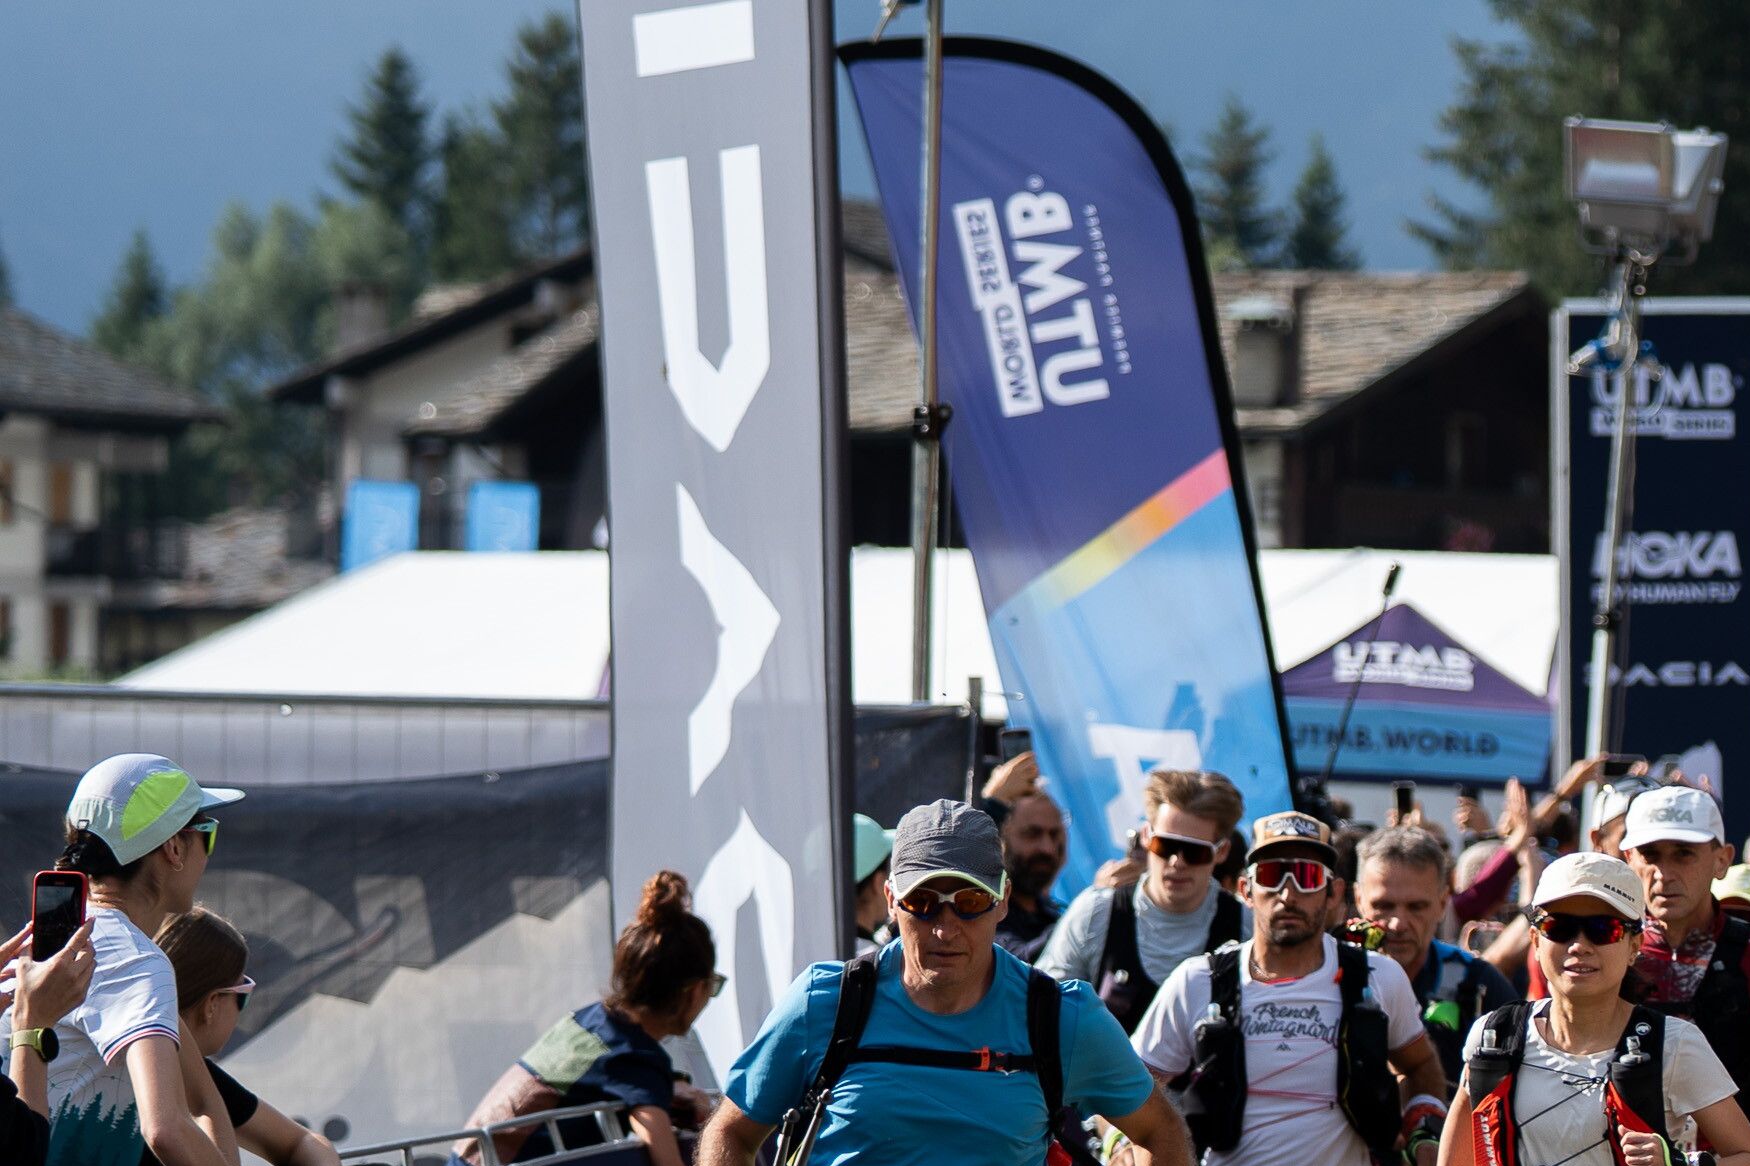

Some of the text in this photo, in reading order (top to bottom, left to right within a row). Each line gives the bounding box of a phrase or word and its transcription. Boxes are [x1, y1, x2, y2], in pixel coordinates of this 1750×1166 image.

[1590, 530, 1743, 578] HOKA
[1333, 641, 1475, 674] UTMB
[1641, 807, 1694, 824] OKA
[1603, 883, 1635, 902] MAMMUT
